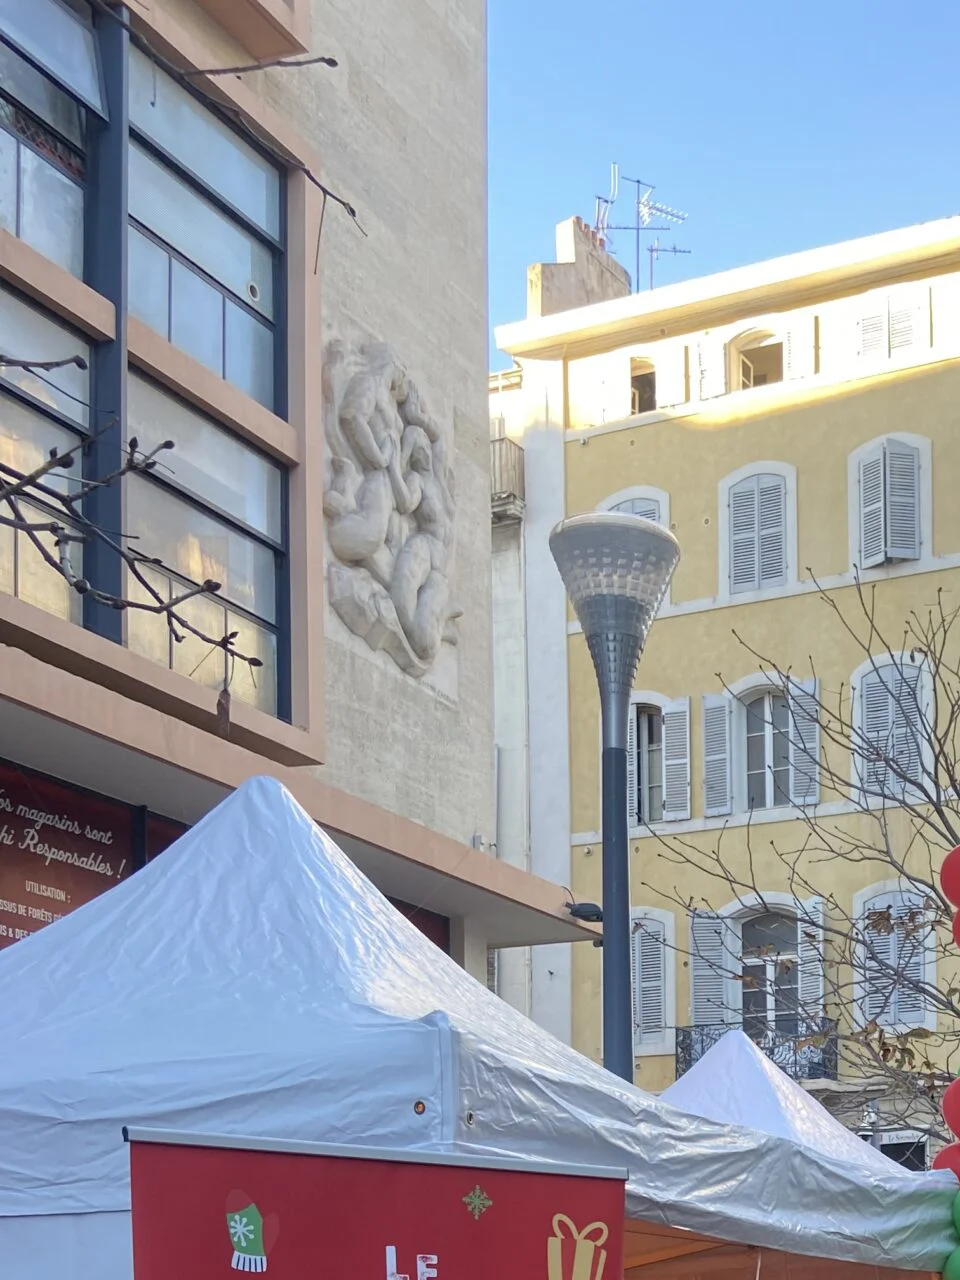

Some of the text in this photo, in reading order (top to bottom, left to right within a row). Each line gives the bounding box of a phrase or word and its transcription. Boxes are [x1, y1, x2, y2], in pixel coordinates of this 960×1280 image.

[16, 804, 82, 834] magasins
[84, 825, 113, 845] sont
[18, 828, 113, 876] Responsables
[116, 859, 126, 879] !
[25, 880, 66, 902] UTILISATION
[17, 903, 28, 916] DE
